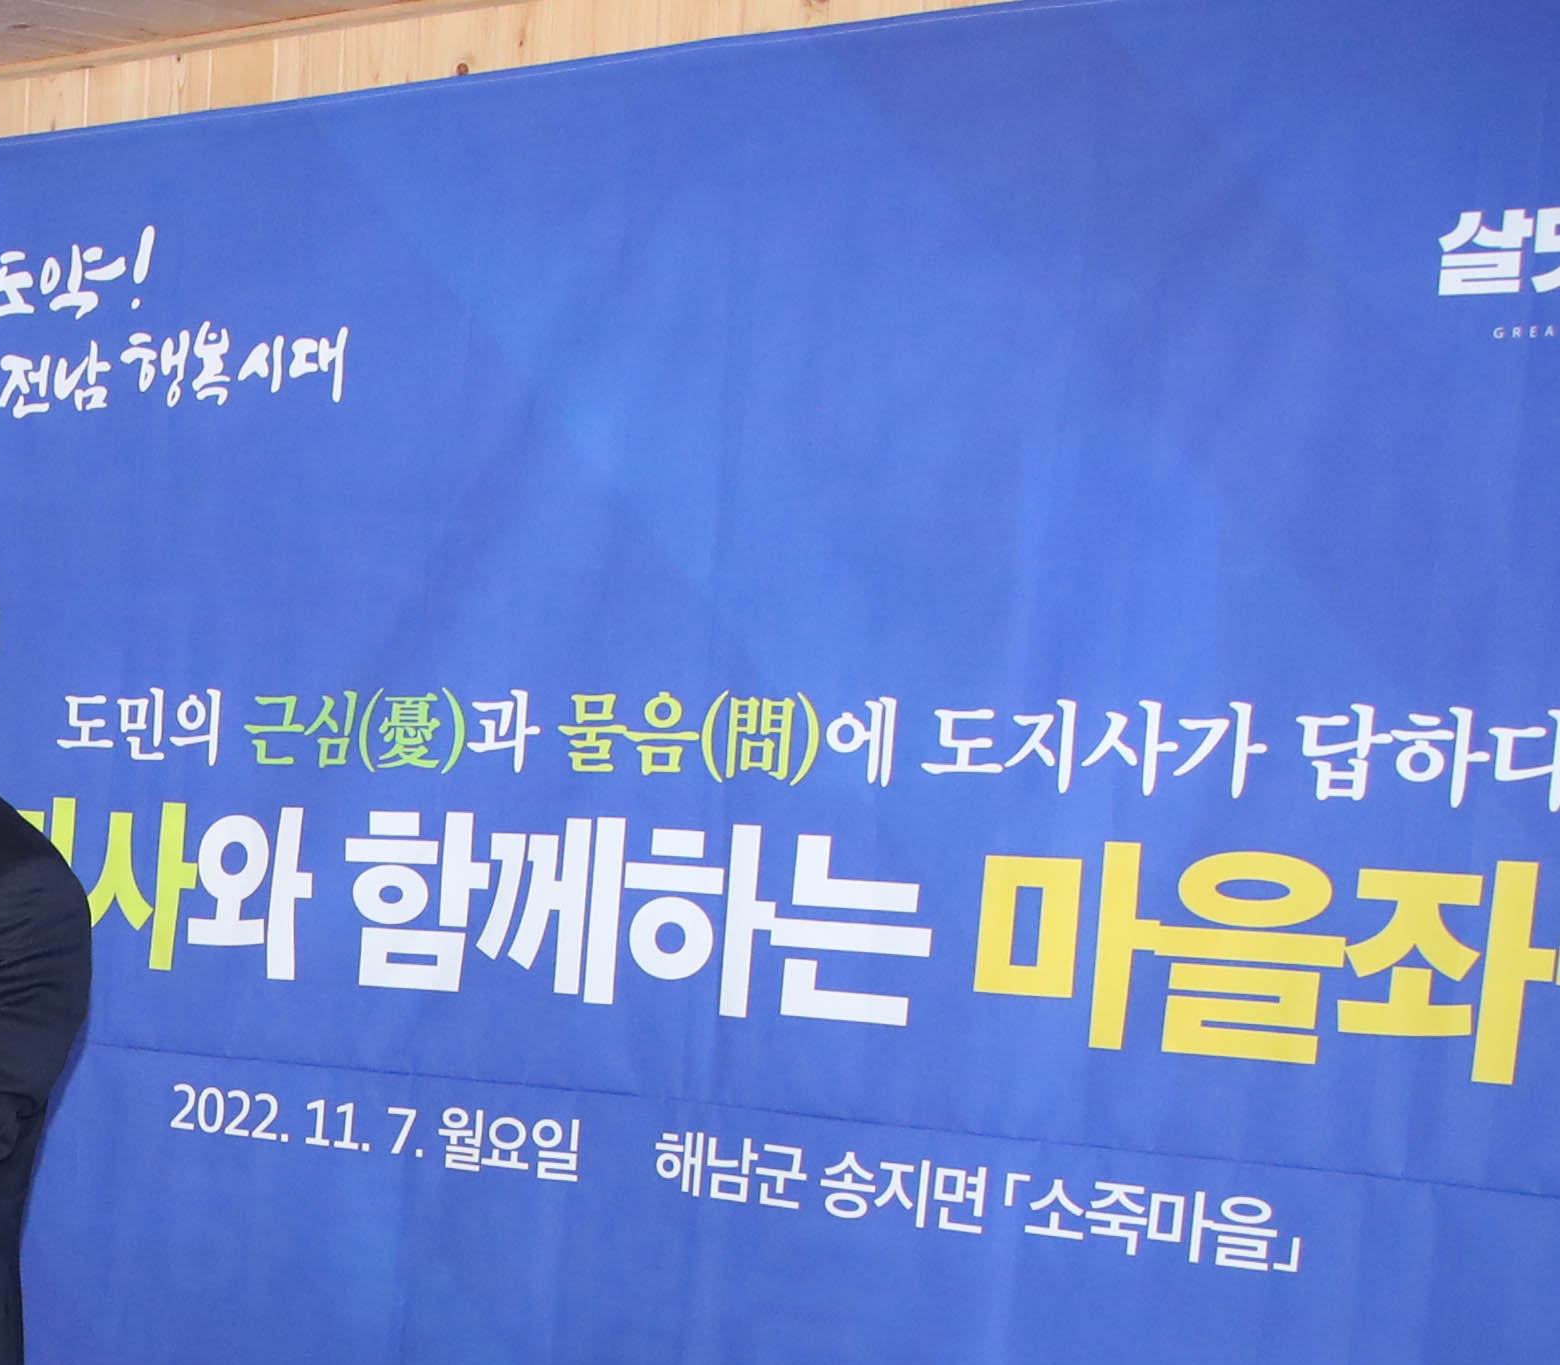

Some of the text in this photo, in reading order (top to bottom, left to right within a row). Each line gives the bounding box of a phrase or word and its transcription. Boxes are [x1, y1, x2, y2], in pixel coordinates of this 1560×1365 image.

[119, 320, 233, 408] 행복
[237, 325, 349, 403] 시대
[56, 686, 1560, 813] 도민의 근심(憂)과 물음(問)에 도지사가 답하다
[344, 810, 933, 1027] 함께하는
[972, 840, 1560, 1086] 마을좌
[170, 1083, 1303, 1273] 2022. 11. 7. 월요일 해남군 송지면 「소죽마을」
